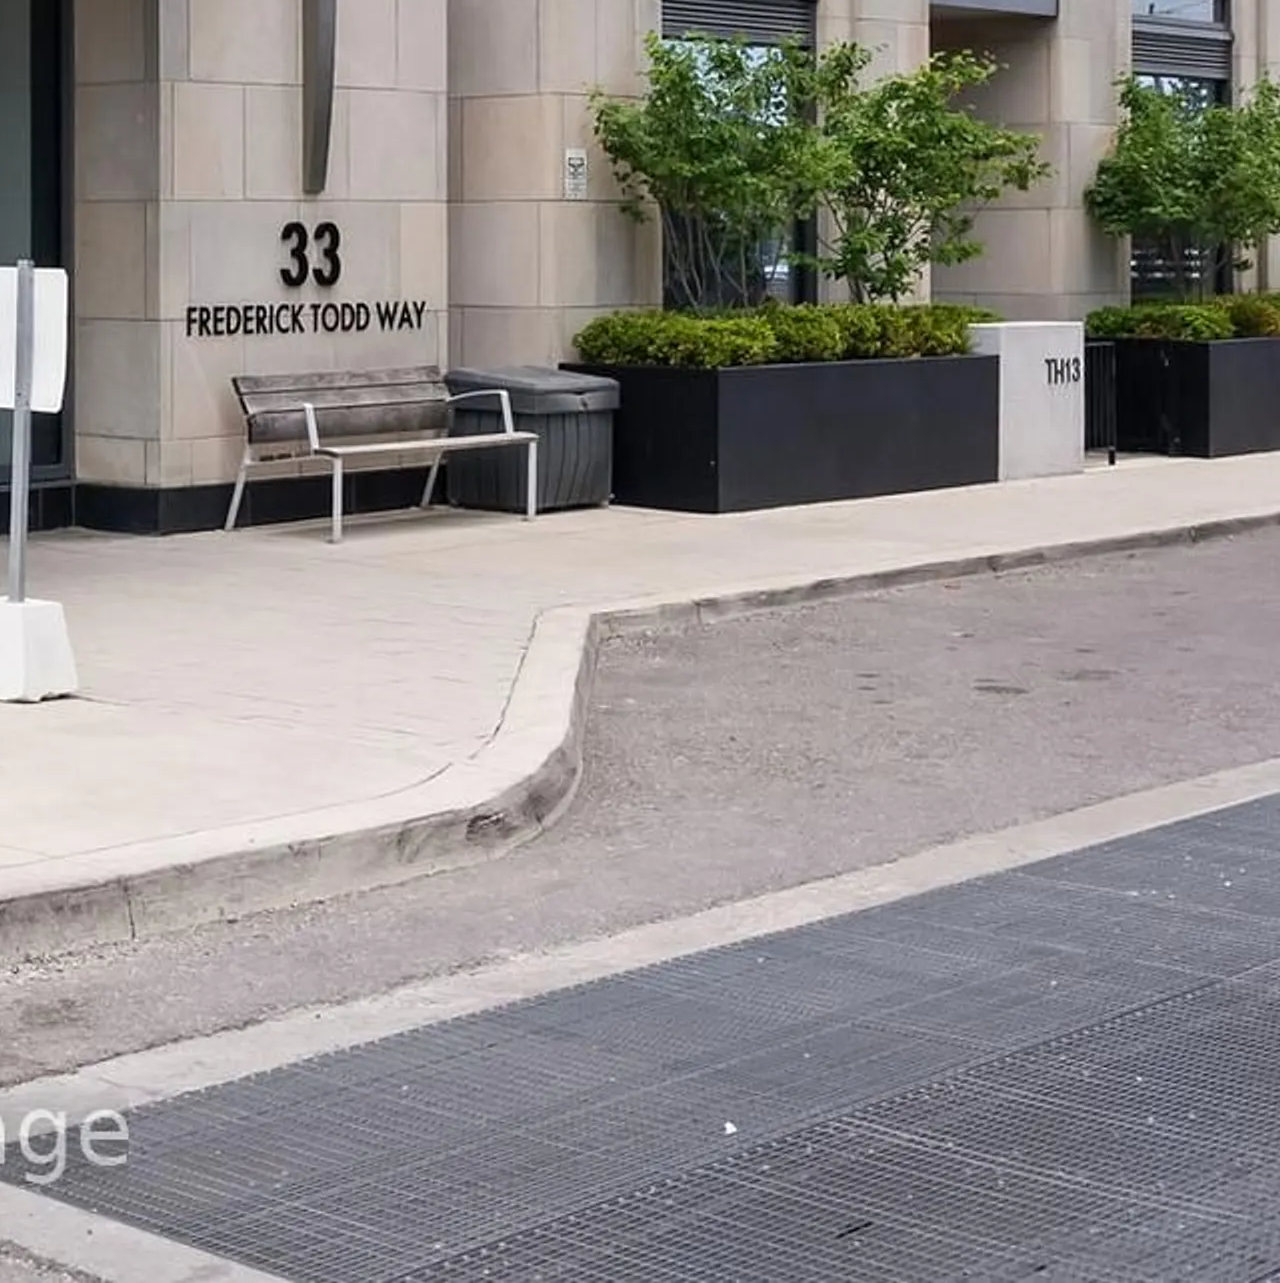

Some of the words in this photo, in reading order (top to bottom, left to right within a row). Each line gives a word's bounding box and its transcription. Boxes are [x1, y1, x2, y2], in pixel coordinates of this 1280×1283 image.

[279, 221, 342, 288] 33
[186, 303, 306, 337] FREDERICK
[309, 301, 371, 333] TODD
[375, 300, 427, 331] WAY
[1044, 357, 1081, 385] TH13
